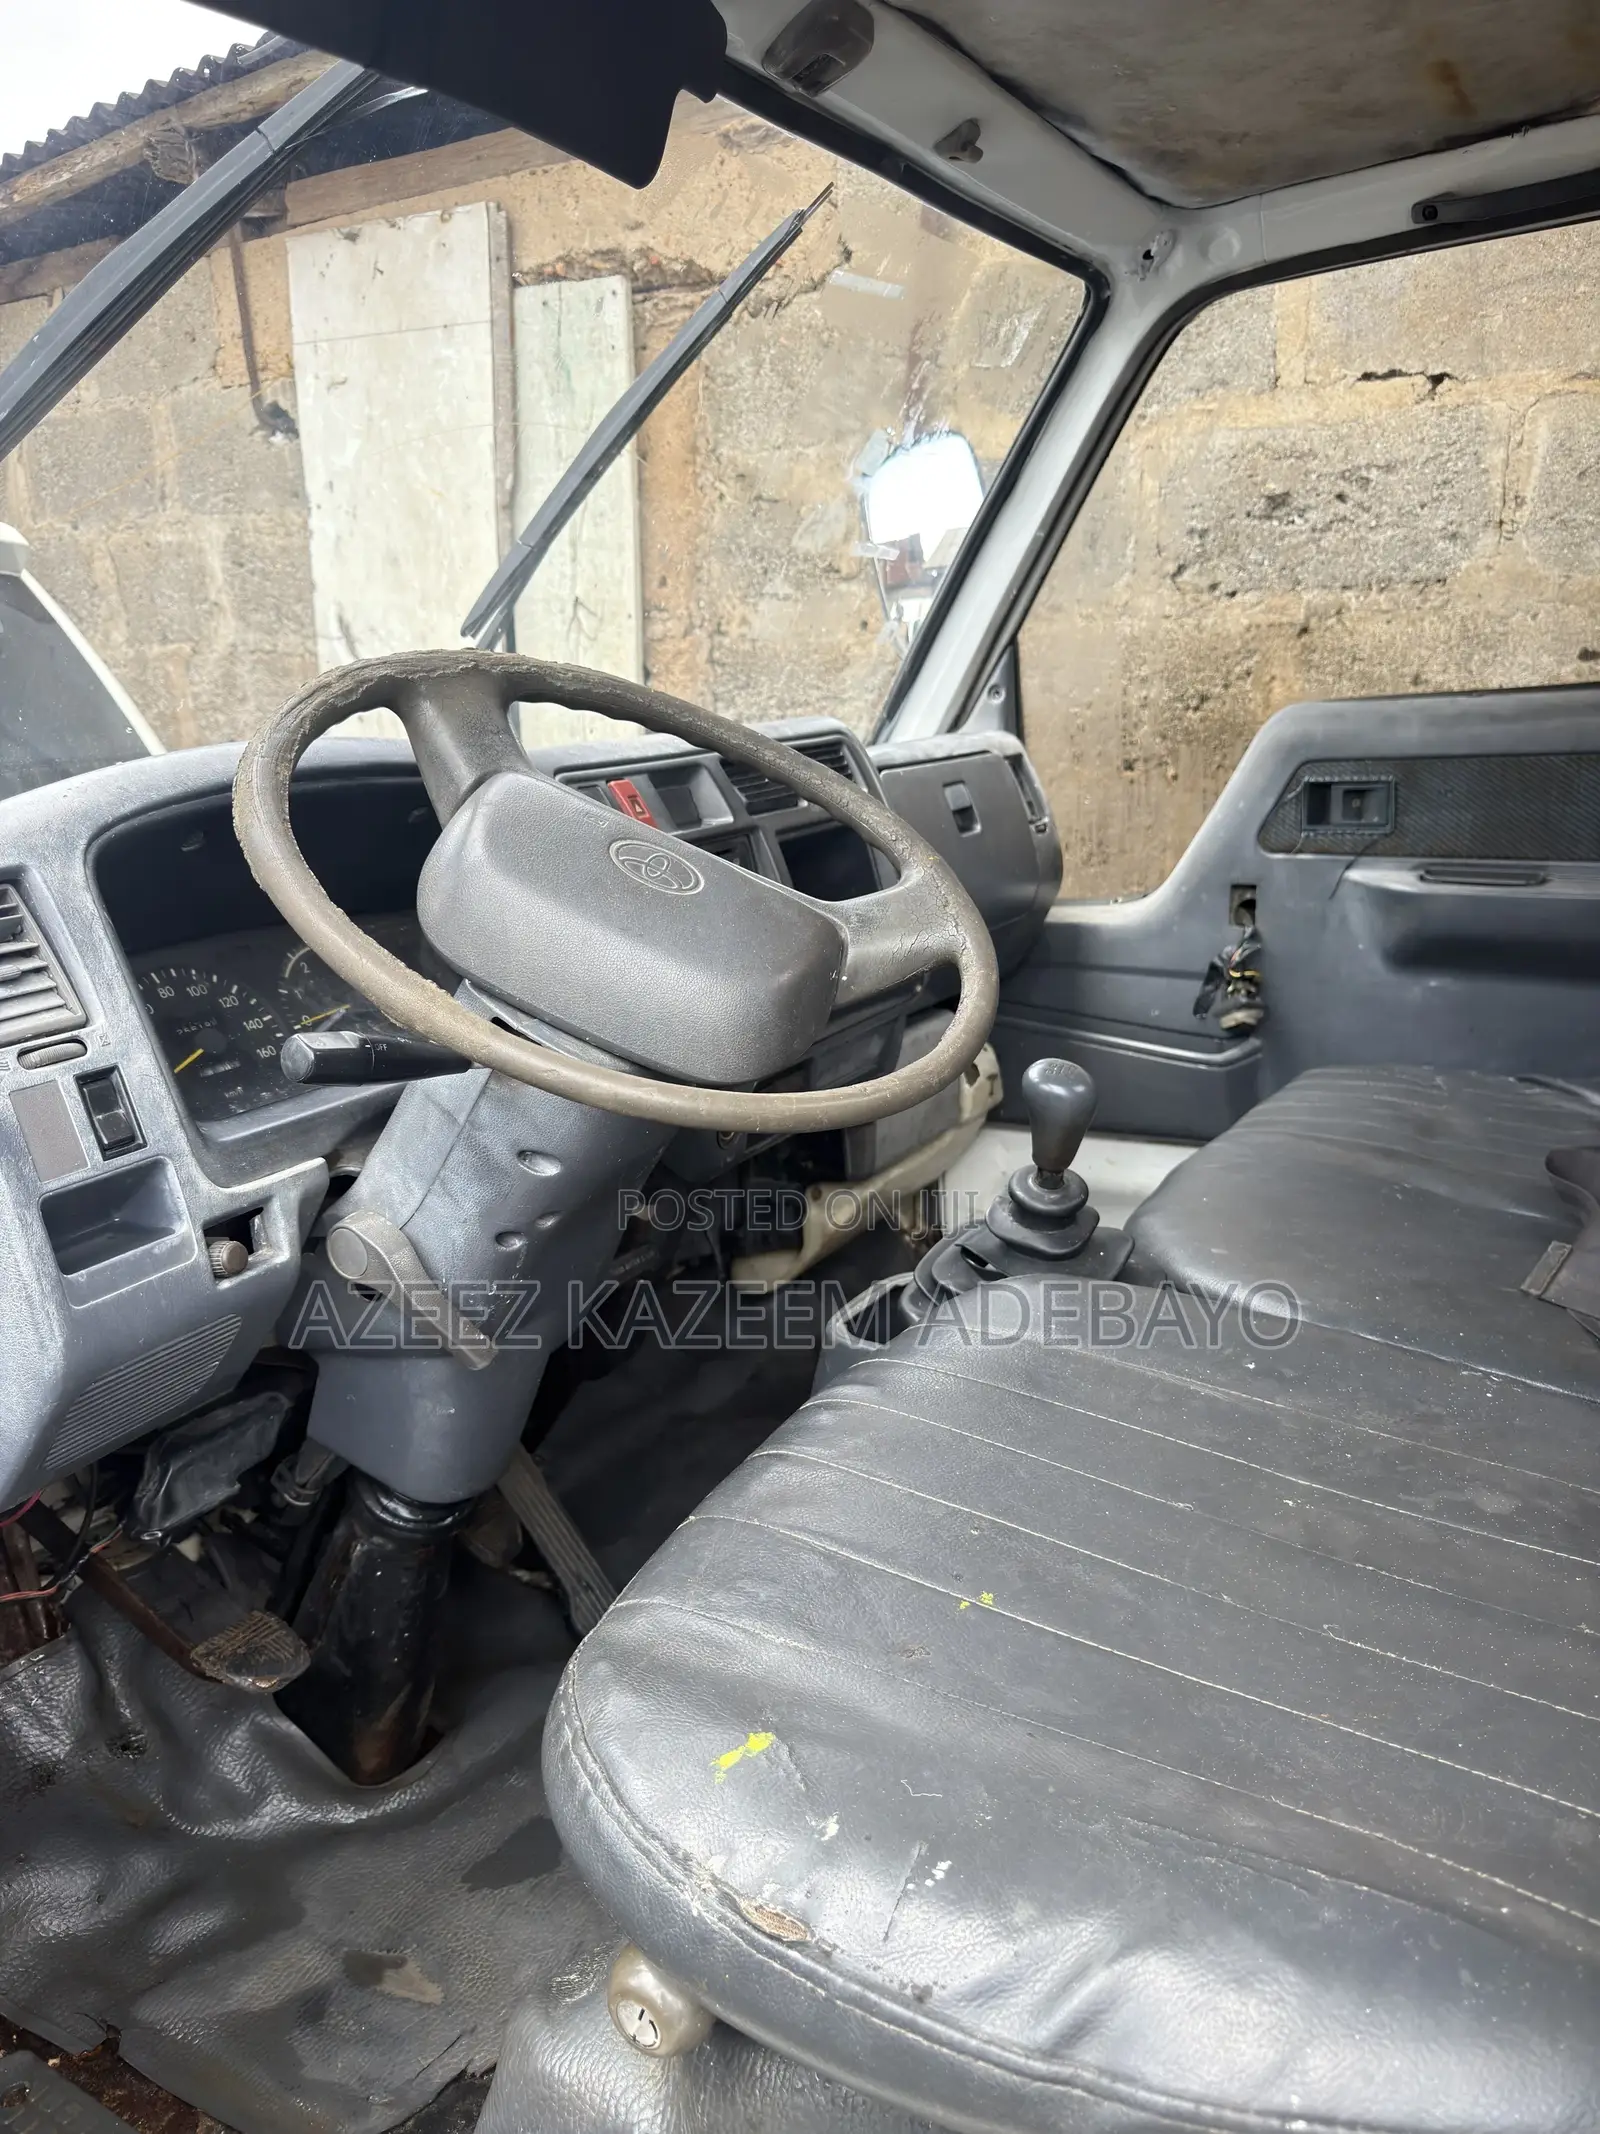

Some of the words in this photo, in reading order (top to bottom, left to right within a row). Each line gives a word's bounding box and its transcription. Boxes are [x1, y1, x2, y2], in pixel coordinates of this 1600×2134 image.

[300, 962, 311, 974] 2
[157, 985, 175, 999] 80
[186, 984, 208, 998] 100
[218, 994, 239, 1009] 120
[243, 1018, 264, 1032] 140
[256, 1045, 277, 1060] 160
[374, 1042, 388, 1051] OFF
